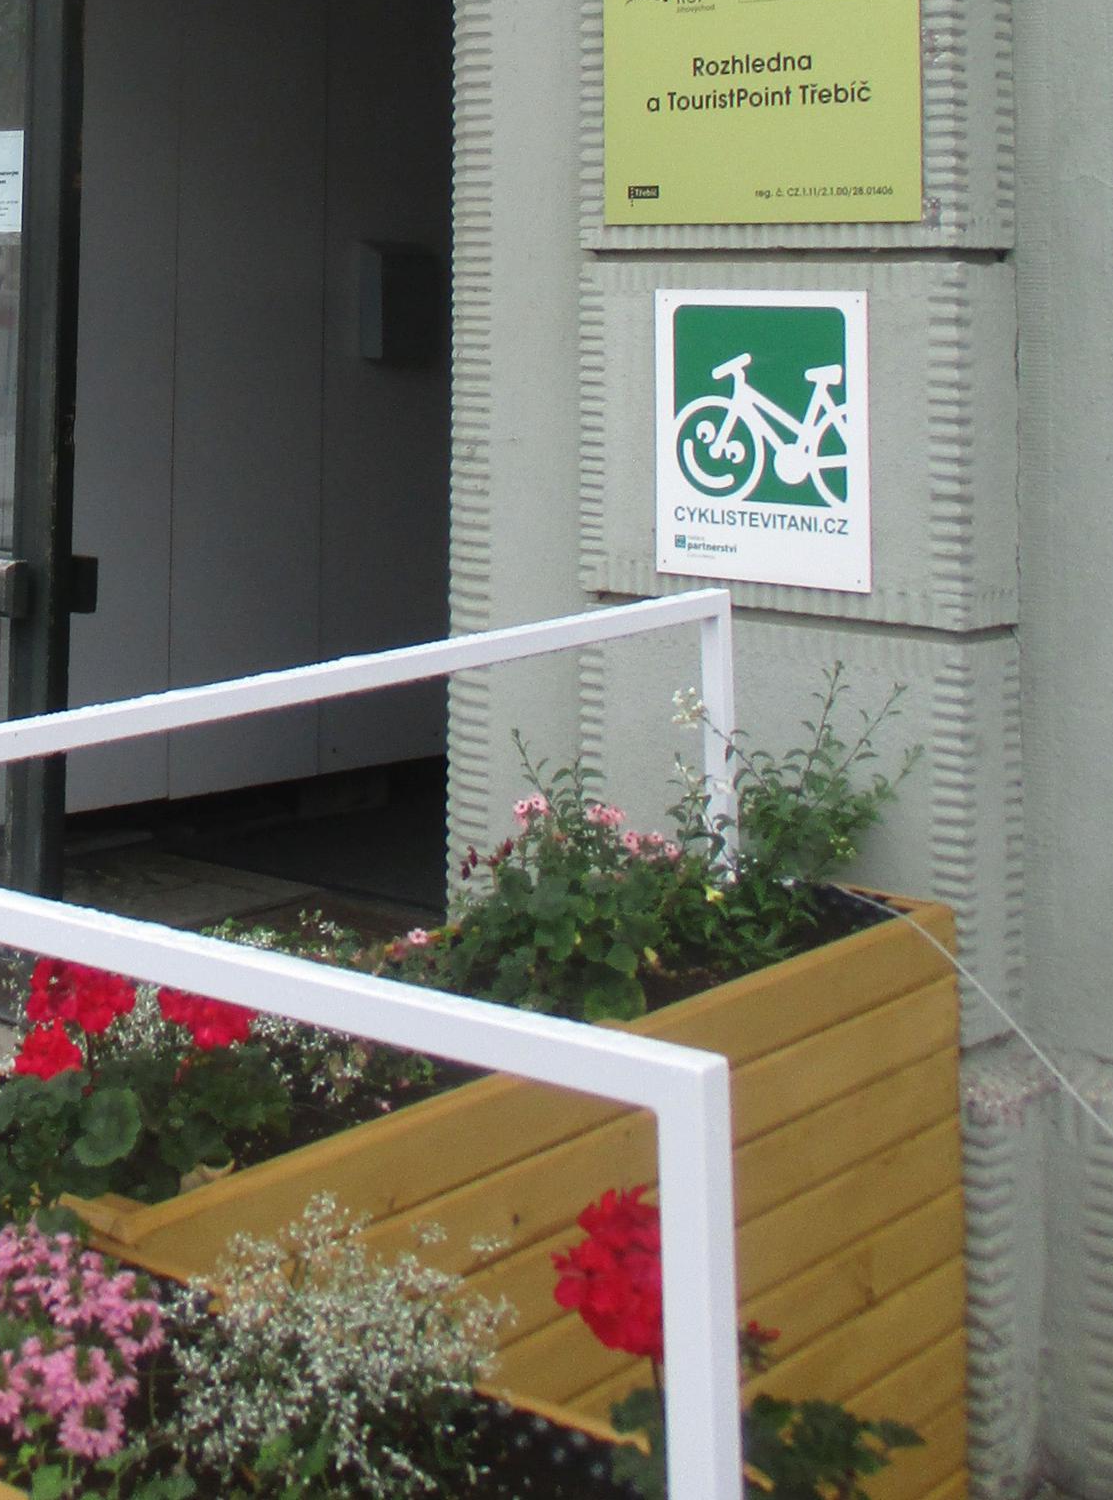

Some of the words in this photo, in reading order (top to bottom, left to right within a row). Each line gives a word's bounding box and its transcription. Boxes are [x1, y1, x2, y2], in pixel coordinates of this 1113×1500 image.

[692, 51, 813, 78] Rozhledna
[646, 95, 661, 113] a
[667, 85, 792, 112] TouristPoint
[799, 80, 872, 106] Třebíč
[754, 189, 774, 199] reg.
[673, 505, 850, 536] CYKLISTEVITANI.CZ
